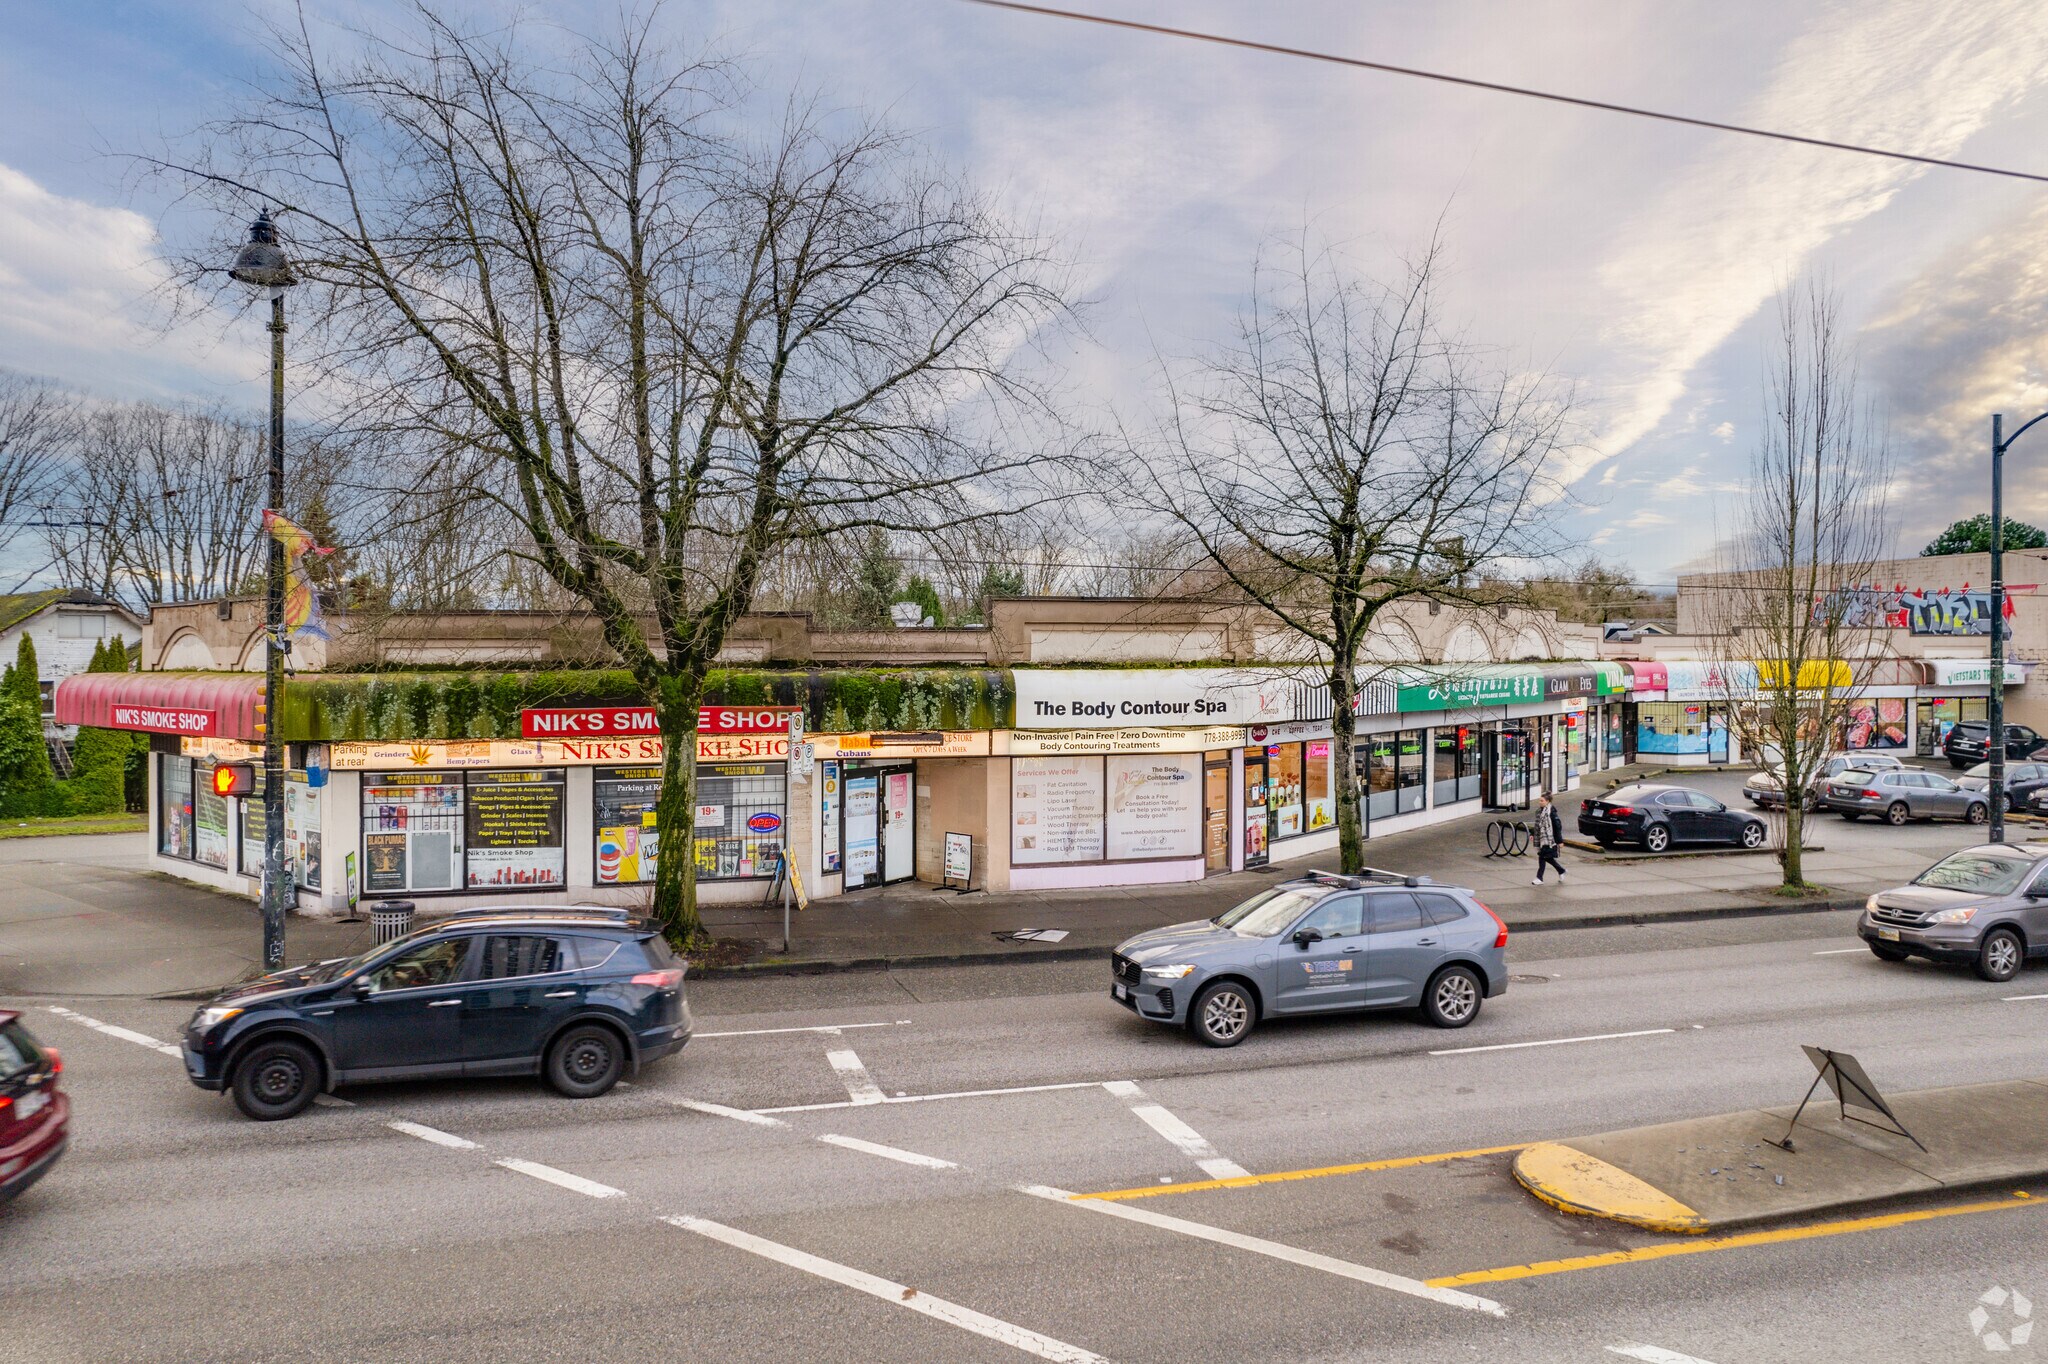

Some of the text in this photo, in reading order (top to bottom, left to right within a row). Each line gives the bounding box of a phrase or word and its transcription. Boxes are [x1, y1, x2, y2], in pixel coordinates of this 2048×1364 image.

[1034, 699, 1227, 719] The Body Contour Spa
[115, 708, 208, 731] NIK'S SMOKE SHOP
[533, 711, 789, 732] NIK'S SME SHOP
[1013, 731, 1186, 741] Non-Invasive Pain Free Zero Downtime
[1203, 730, 1246, 743] 778-388-9993
[841, 736, 876, 748] Haba
[1040, 741, 1160, 751] Body Contouring Treatments
[333, 744, 368, 756] Parking
[560, 738, 802, 760] NIK'S SKE SHO
[335, 757, 366, 767] at rear
[446, 758, 466, 766] Hemp
[701, 807, 716, 815] 19+
[895, 811, 904, 819] 19+
[749, 818, 780, 828] OPEN
[385, 835, 406, 844] PUMAS
